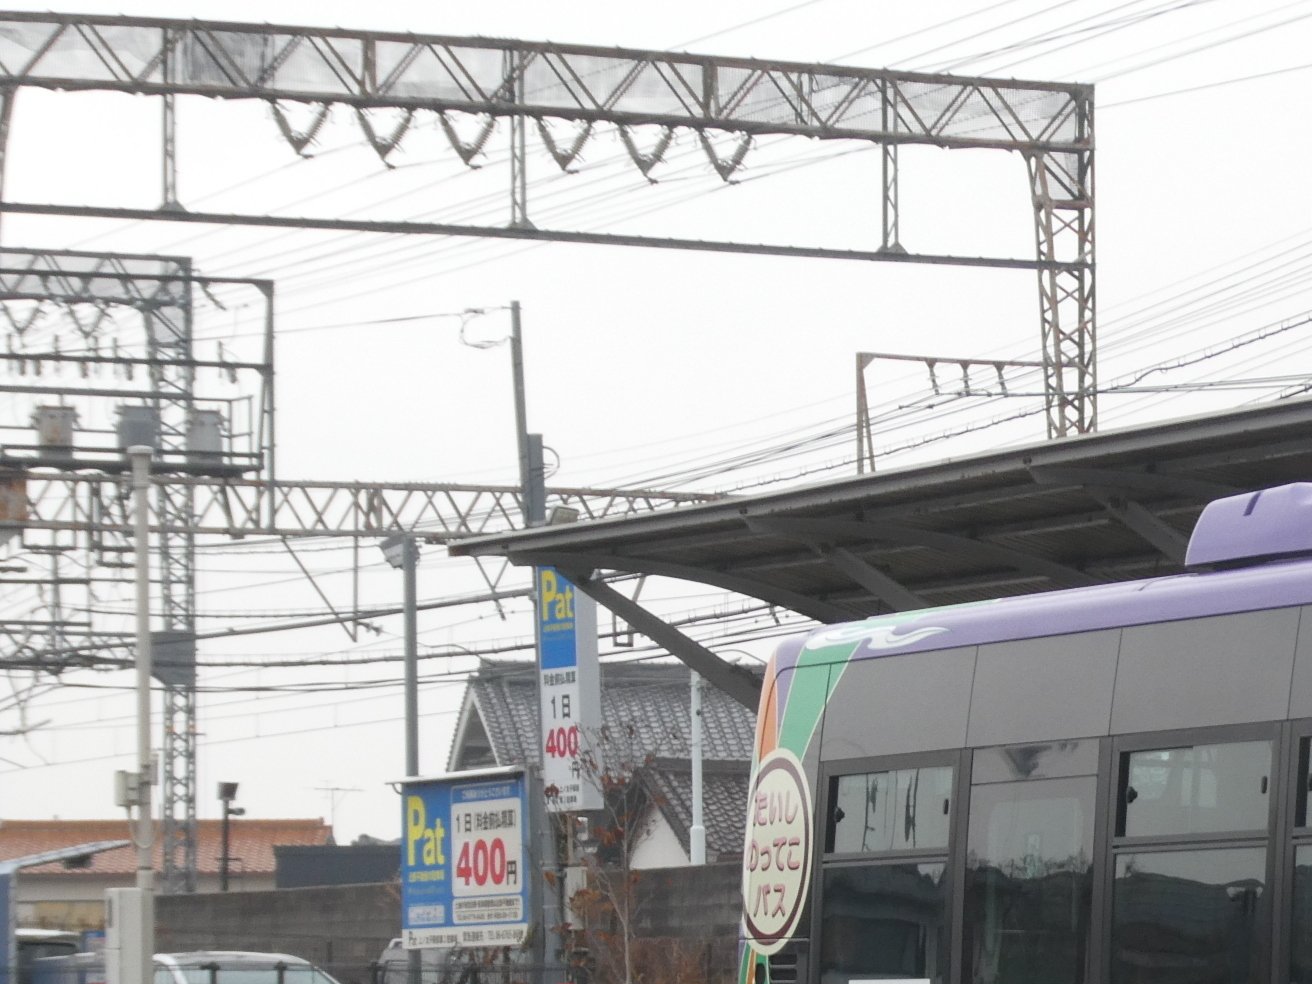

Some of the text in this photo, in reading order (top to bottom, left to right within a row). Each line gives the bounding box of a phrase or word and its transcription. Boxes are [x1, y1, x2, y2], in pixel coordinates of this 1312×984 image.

[541, 570, 574, 621] Pat
[550, 694, 571, 719] 1日
[545, 726, 578, 758] 400
[754, 790, 799, 827] たいし
[407, 795, 445, 866] Pat
[746, 836, 800, 872] のってこ
[753, 883, 786, 918] バス
